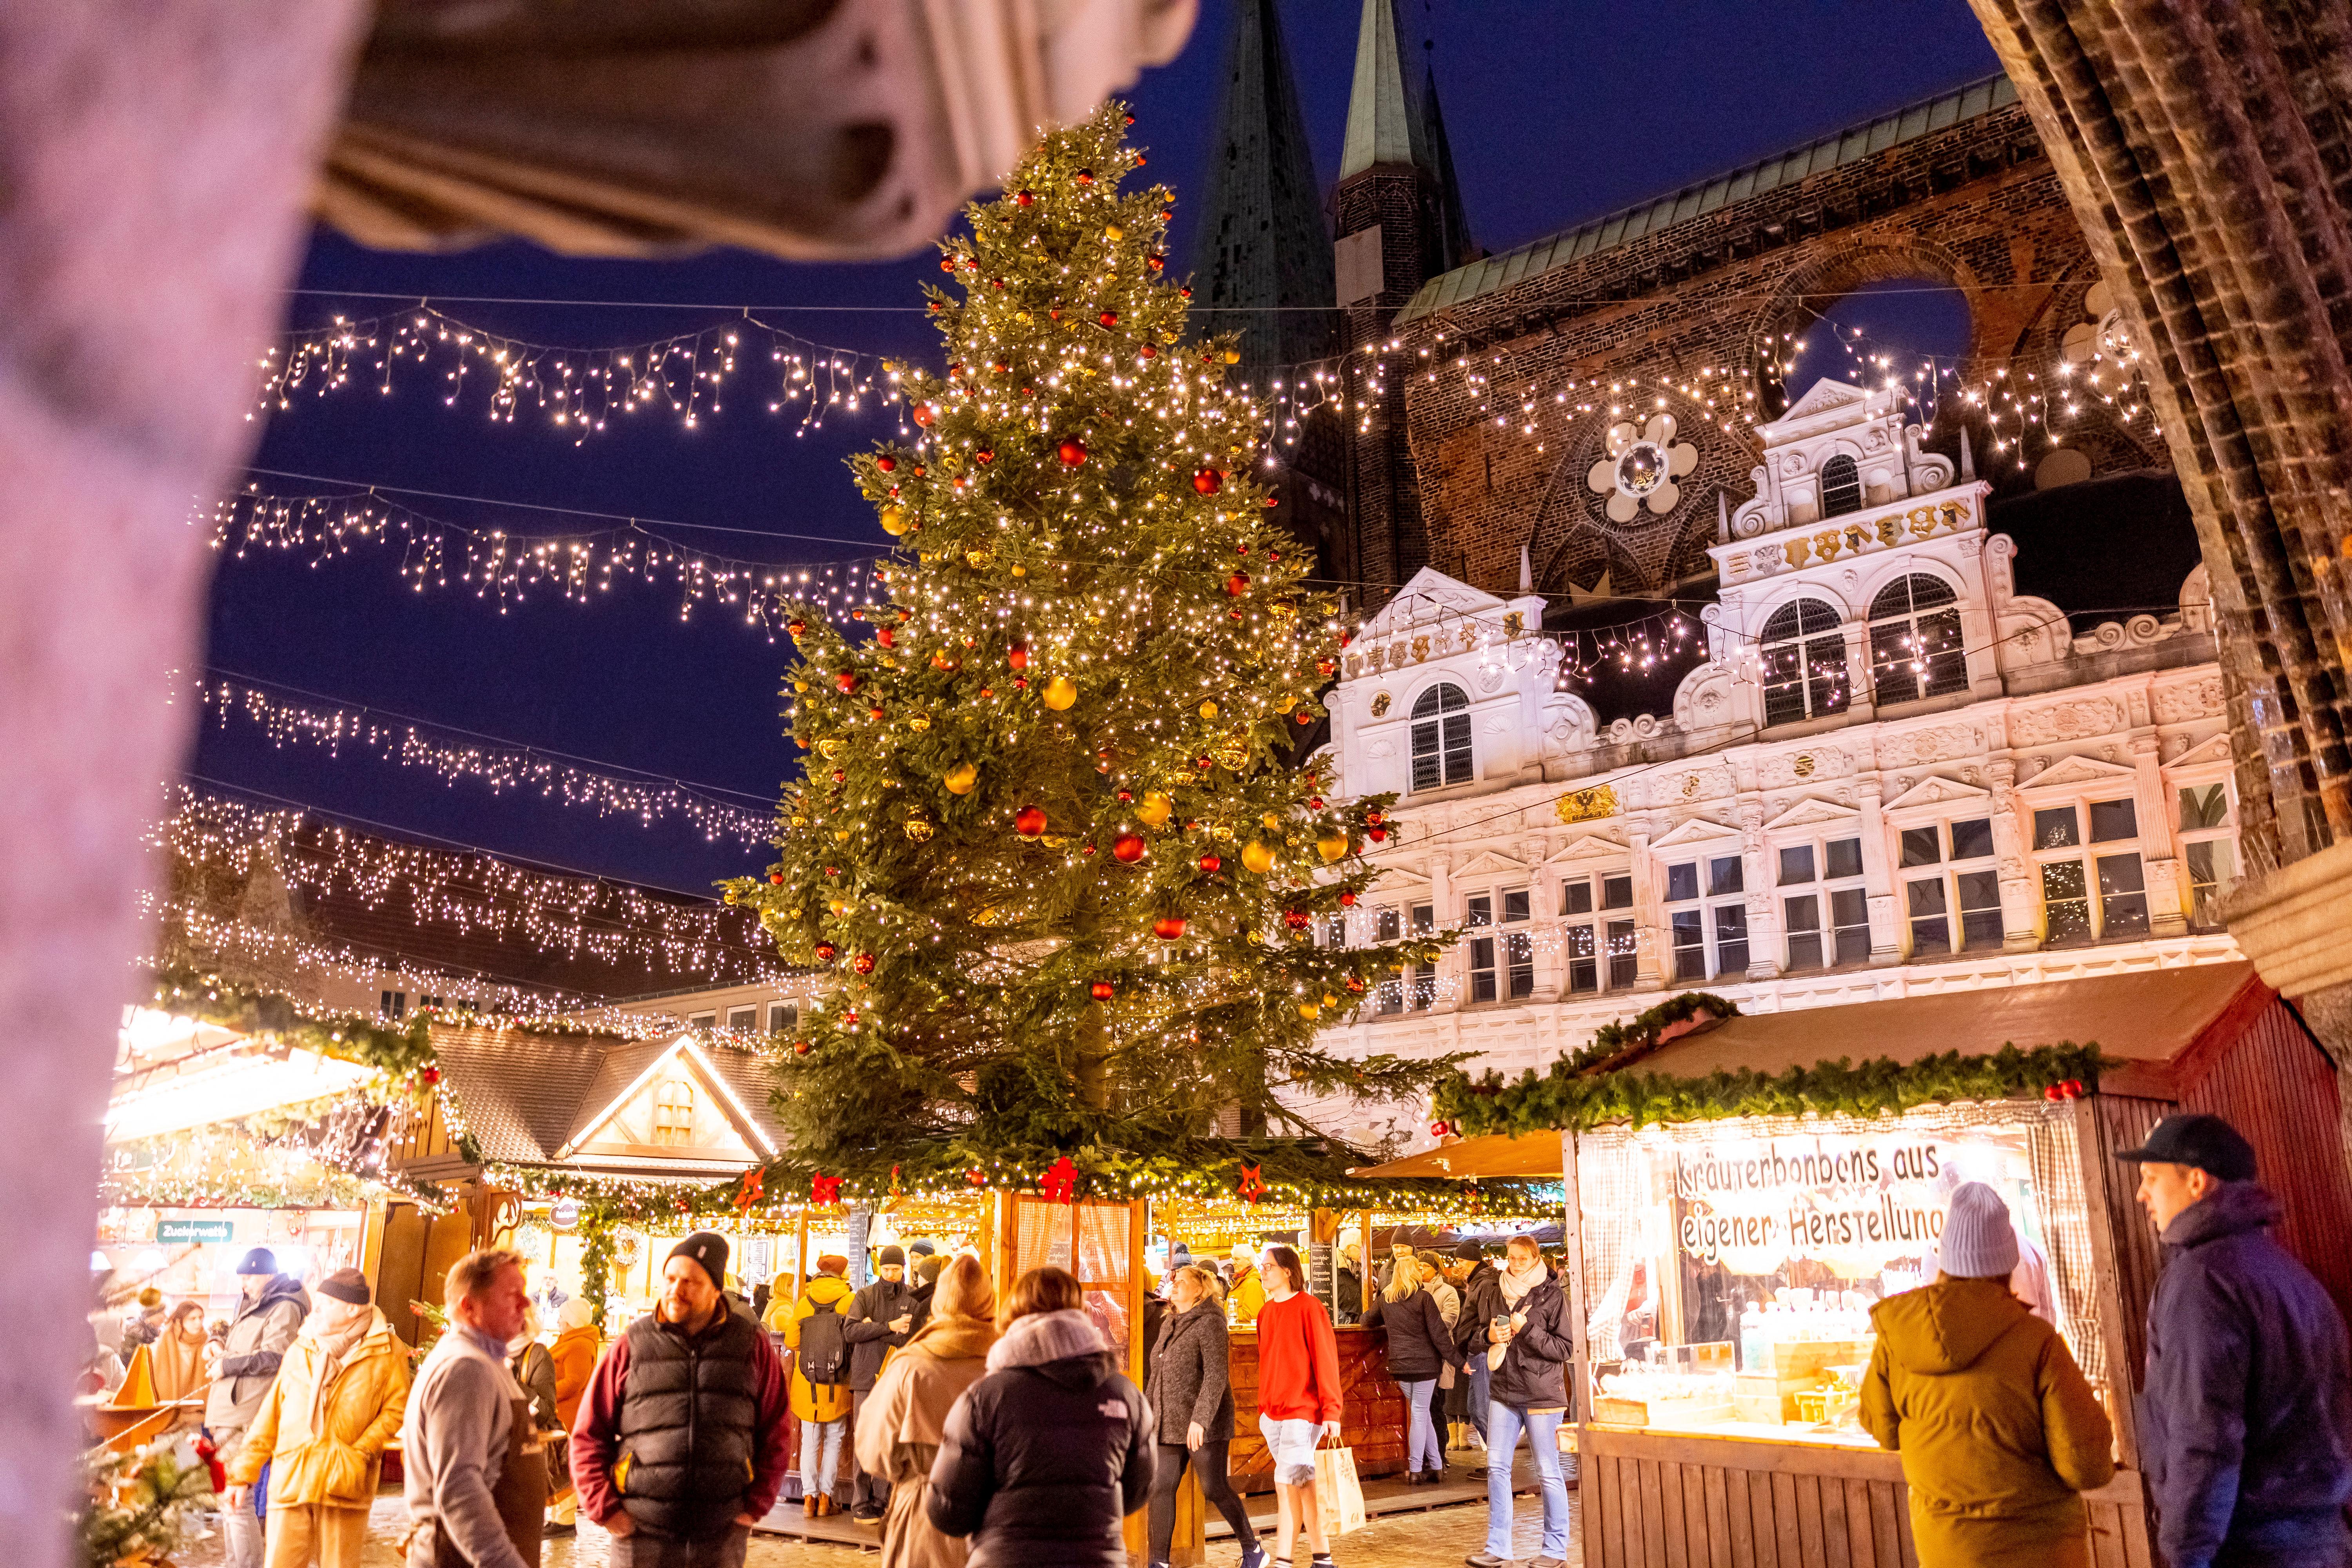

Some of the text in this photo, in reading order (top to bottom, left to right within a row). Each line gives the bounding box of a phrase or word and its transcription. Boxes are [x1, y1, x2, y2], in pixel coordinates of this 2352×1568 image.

[1894, 1145, 1939, 1180] aus
[163, 1225, 228, 1237] Zuckerwatte
[1684, 1206, 1772, 1261] eigener
